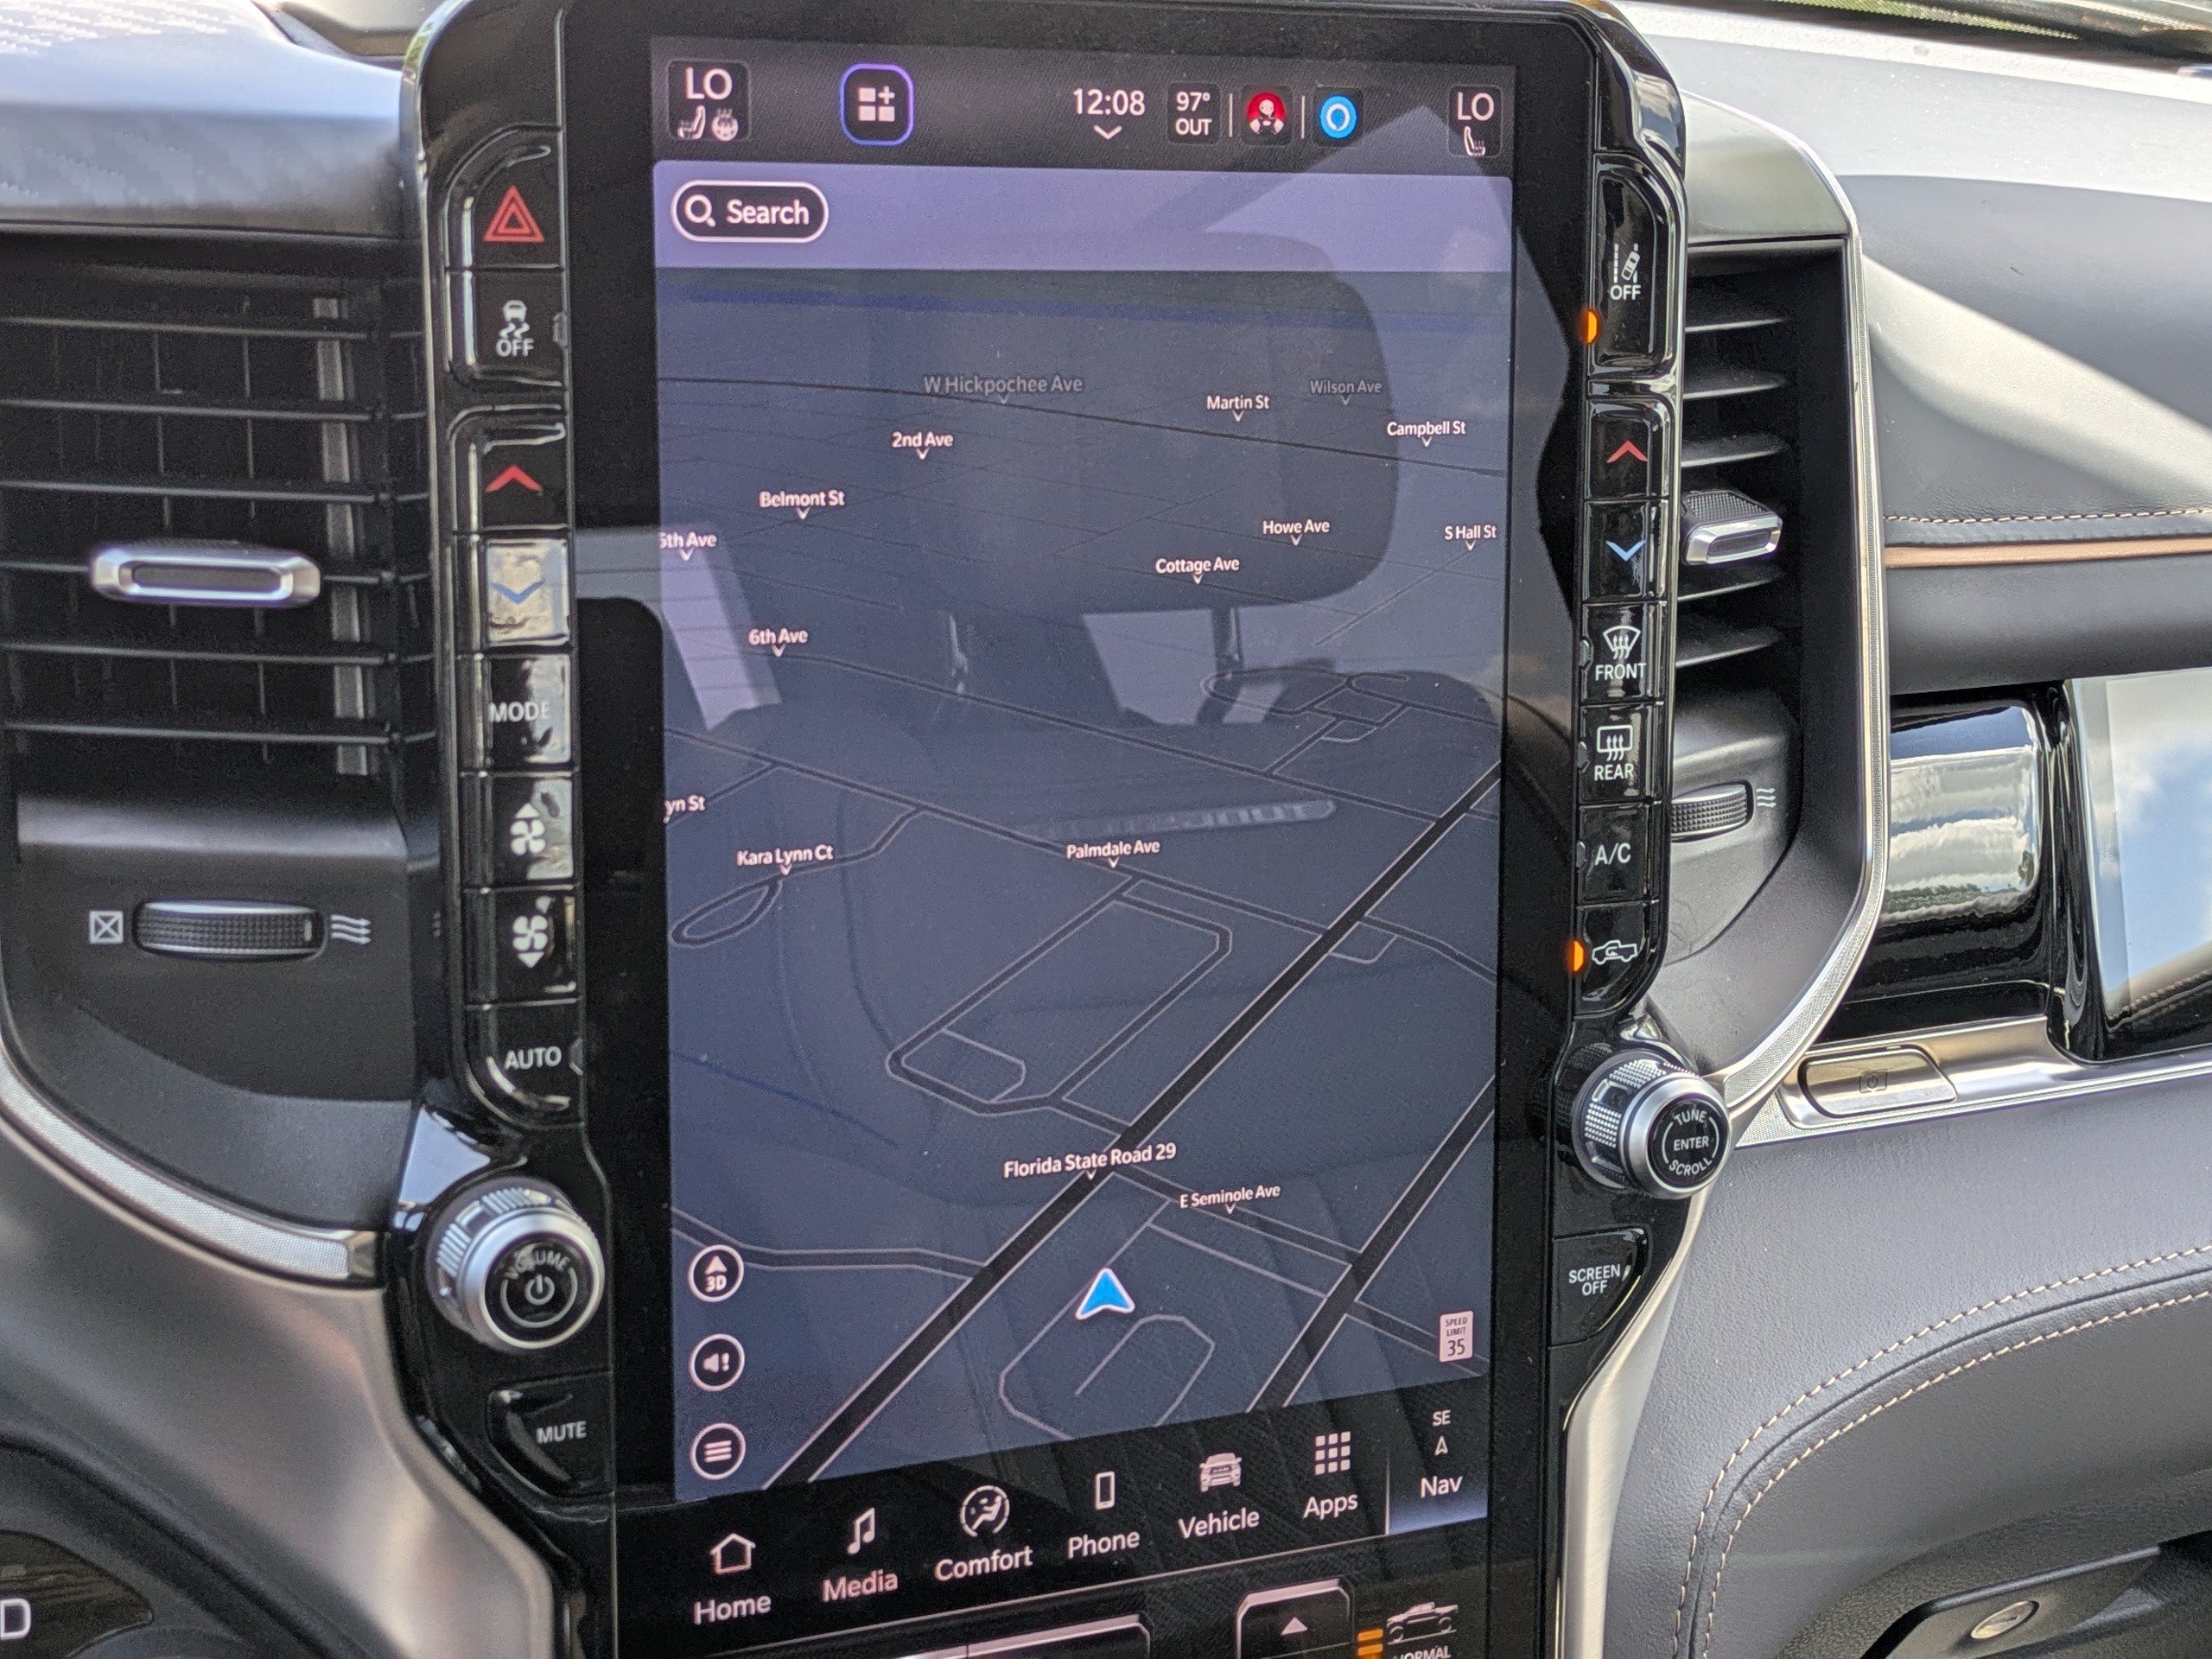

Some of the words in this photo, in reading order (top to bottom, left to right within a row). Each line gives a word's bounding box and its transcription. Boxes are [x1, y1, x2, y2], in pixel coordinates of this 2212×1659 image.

[684, 66, 734, 100] LO
[1072, 88, 1146, 116] 12:08
[1175, 91, 1211, 112] 97°
[1456, 92, 1496, 120] LO
[1174, 118, 1213, 136] OUT
[726, 199, 810, 226] Search
[1610, 284, 1642, 301] OFF
[495, 338, 535, 357] OFF
[923, 375, 941, 393] W
[944, 375, 1047, 396] Hickpochee
[1050, 374, 1084, 392] Ave
[1310, 380, 1355, 395] Wilson
[1357, 380, 1382, 394] Ave
[1206, 395, 1253, 410] Martin
[1255, 395, 1270, 410] St
[1387, 421, 1451, 437] Campbell
[1452, 421, 1466, 435] St
[892, 431, 923, 448] 2nd
[924, 432, 954, 448] Ave
[759, 490, 826, 508] Belmont
[828, 489, 845, 506] St
[1262, 520, 1302, 535] Howe
[1304, 519, 1331, 534] Ave
[1444, 525, 1453, 540] S
[1455, 525, 1482, 540] Hall
[1483, 524, 1497, 539] St
[685, 531, 718, 548] Ave
[1155, 558, 1211, 576] Cottage
[1213, 557, 1240, 572] Ave
[748, 628, 778, 645] 6th
[779, 628, 809, 645] Ave
[1594, 662, 1647, 682] FRONT
[488, 701, 550, 722] MODE
[1593, 764, 1635, 781] REAR
[687, 794, 706, 811] St
[737, 848, 770, 868] Kara
[774, 846, 810, 868] Lynn
[812, 844, 834, 863] Ct
[1066, 842, 1133, 860] Palmdale
[1134, 840, 1160, 855] Ave
[1594, 842, 1632, 865] A/C
[504, 1046, 563, 1070] AUTO
[1673, 1109, 1708, 1125] TUNE
[1673, 1135, 1710, 1152] ENTER
[1003, 1154, 1062, 1179] Florida
[1065, 1149, 1108, 1172] State
[1109, 1146, 1153, 1166] Road
[1155, 1143, 1177, 1162] 29
[1669, 1156, 1713, 1177] SCROLL
[1179, 1194, 1189, 1209] E
[1191, 1187, 1254, 1207] Seminole
[1255, 1185, 1281, 1199] Ave
[1568, 1263, 1622, 1283] SCREEN
[705, 1274, 727, 1293] 3D
[1581, 1280, 1608, 1296] OFF
[1445, 1316, 1468, 1327] SPEED
[1446, 1326, 1466, 1338] LIMIT
[1447, 1338, 1465, 1357] 35
[1432, 1409, 1452, 1426] SE
[536, 1420, 588, 1445] MUTE
[1420, 1476, 1464, 1498] Nav
[1302, 1493, 1358, 1520] Apps
[1178, 1507, 1261, 1540] Vehicle
[1068, 1529, 1141, 1560] Phone
[934, 1545, 1033, 1582] Comfort
[821, 1569, 899, 1602] Media
[693, 1594, 772, 1626] Home
